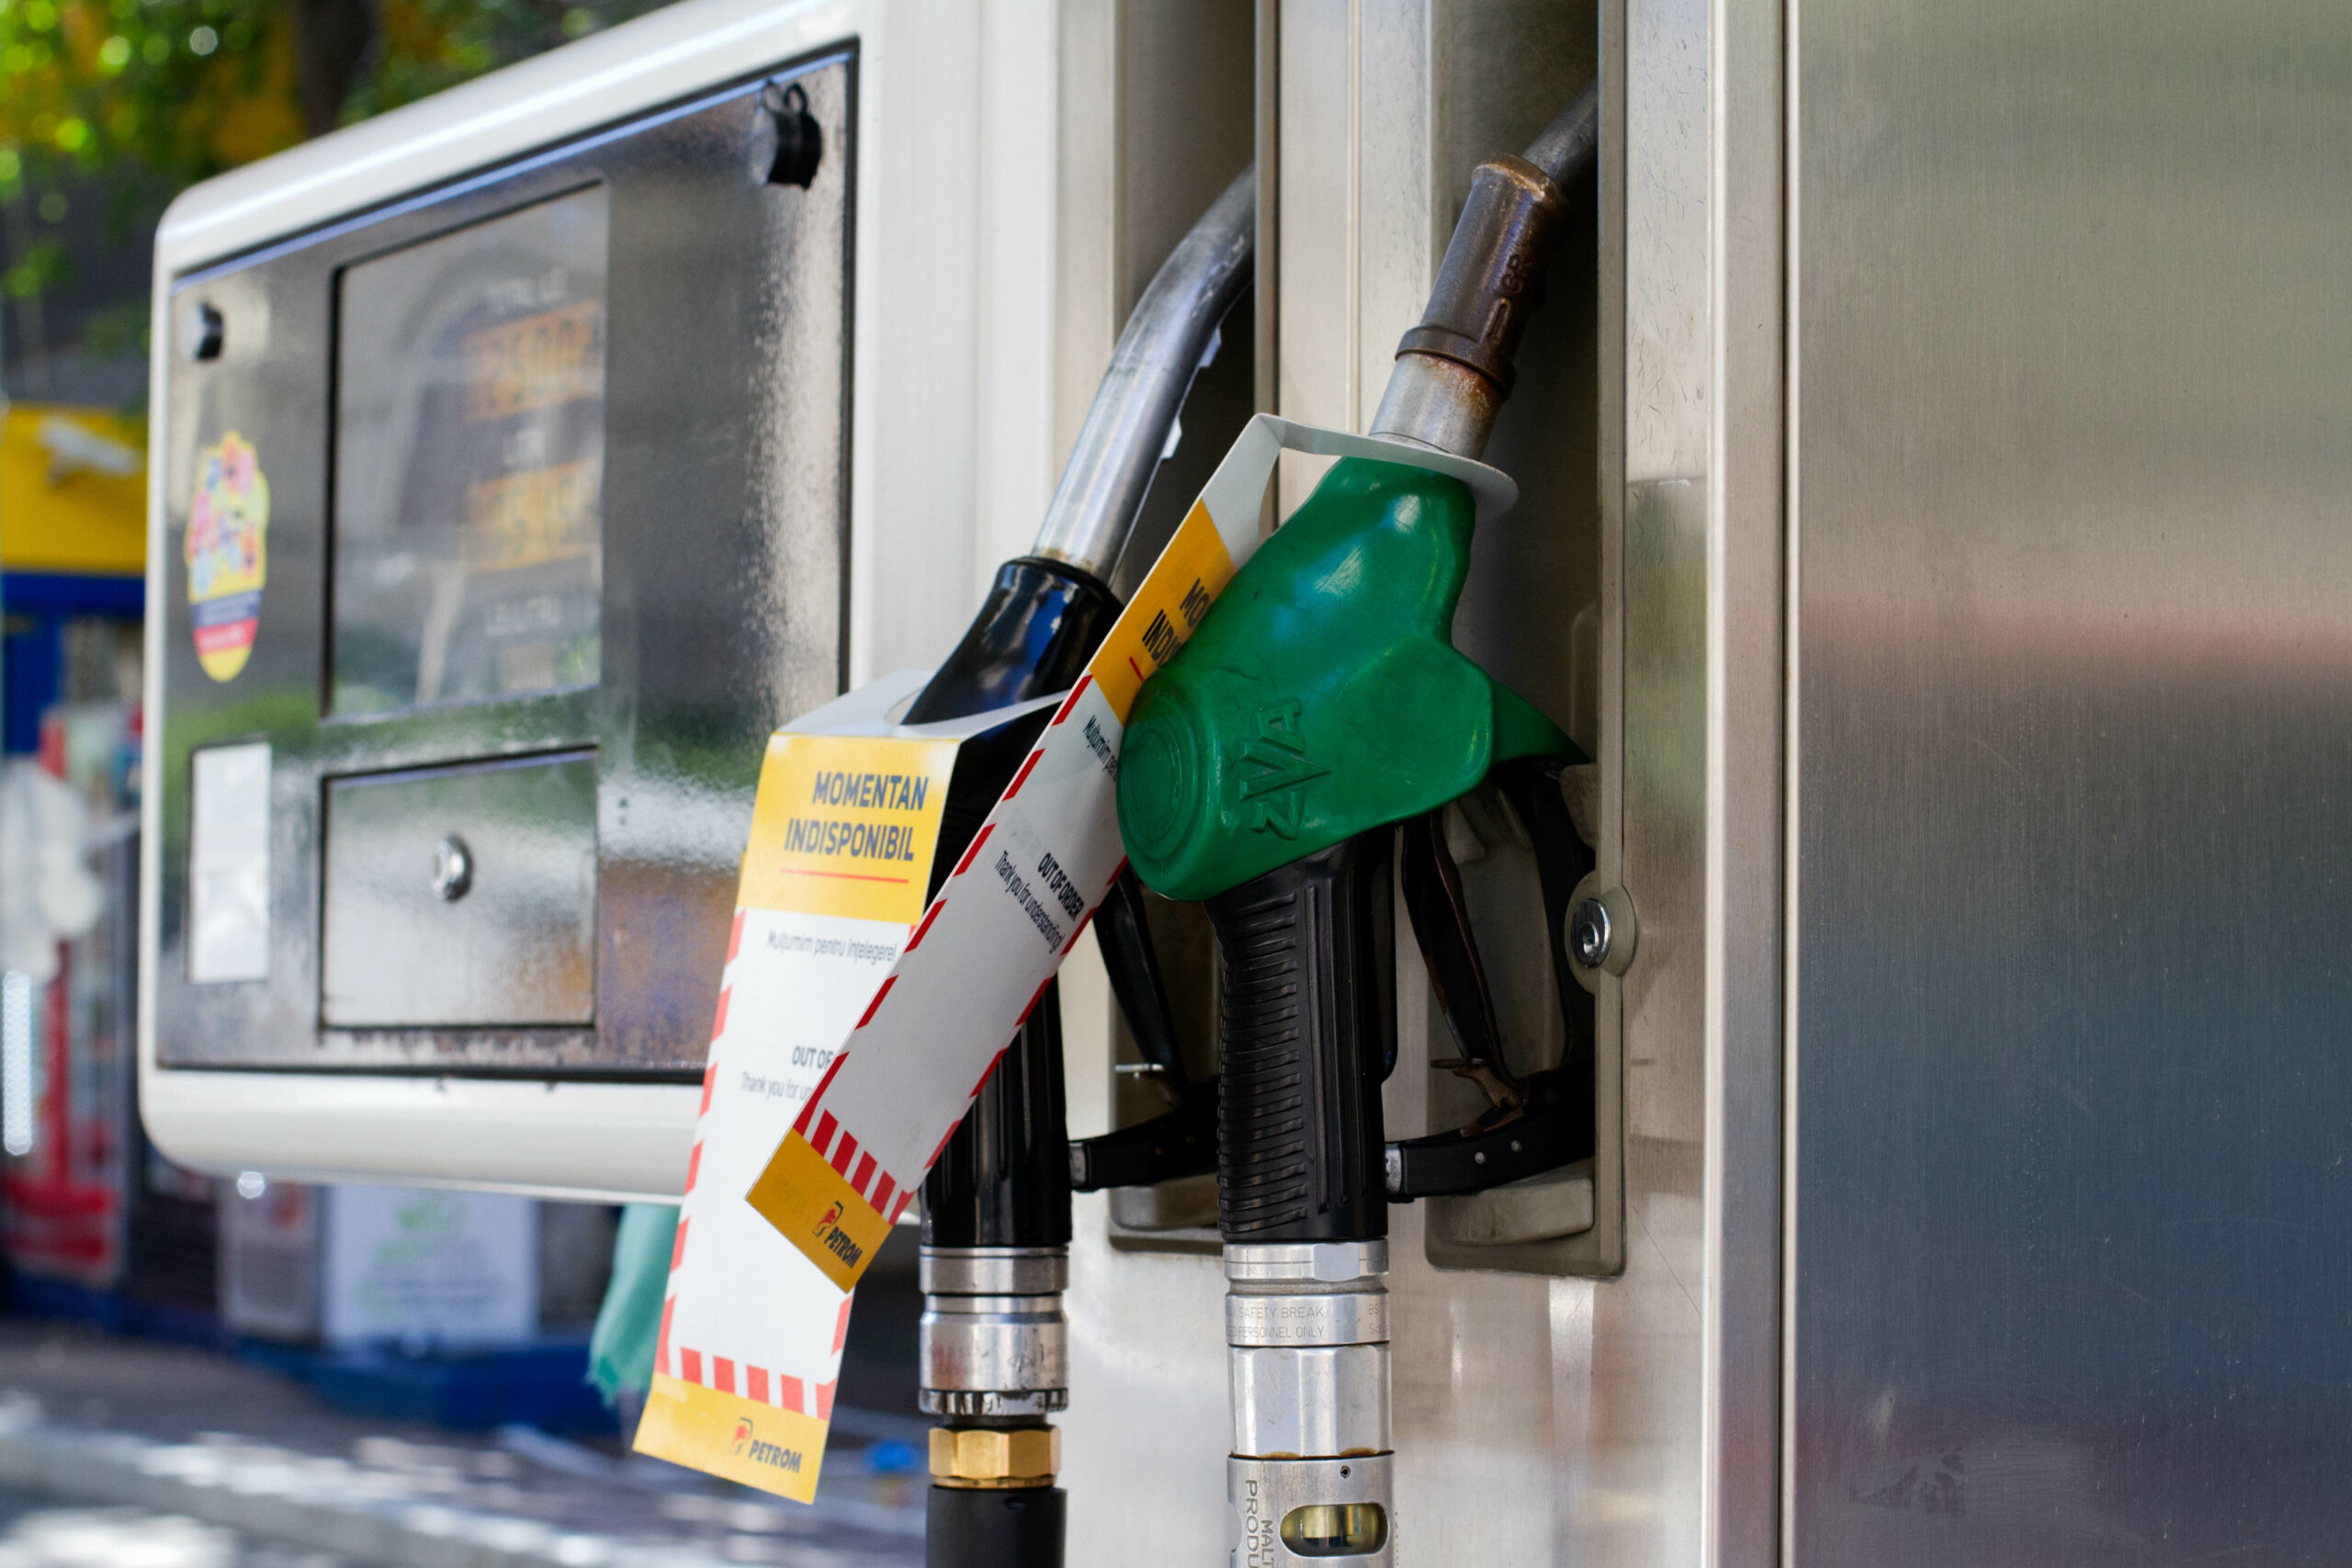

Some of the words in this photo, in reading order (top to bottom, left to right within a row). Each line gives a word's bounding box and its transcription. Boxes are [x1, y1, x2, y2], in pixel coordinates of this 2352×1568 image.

[1179, 577, 1210, 627] MO
[1142, 608, 1180, 668] INDI
[811, 771, 929, 811] MOMENTAN
[785, 818, 915, 862] INDISPONIBIL
[994, 850, 1017, 885] Thank
[1037, 852, 1059, 884] OUT
[1049, 870, 1068, 894] OF
[1005, 874, 1024, 897] you
[1017, 882, 1032, 907] for
[1057, 881, 1084, 922] ORDER
[814, 938, 846, 958] pentru
[791, 1045, 818, 1067] OUT
[817, 1049, 834, 1069] OF
[741, 1070, 766, 1094] Thank
[766, 1079, 785, 1100] you
[786, 1078, 799, 1100] for
[823, 1225, 863, 1269] PETROM
[1239, 1306, 1277, 1319] SAFETY
[1281, 1306, 1324, 1319] BREAK
[1238, 1325, 1292, 1338] PERSONNEL
[1295, 1325, 1324, 1338] ONLY
[748, 1439, 802, 1473] PETROM
[1245, 1479, 1261, 1568] PRODU
[1261, 1519, 1275, 1568] MALT
